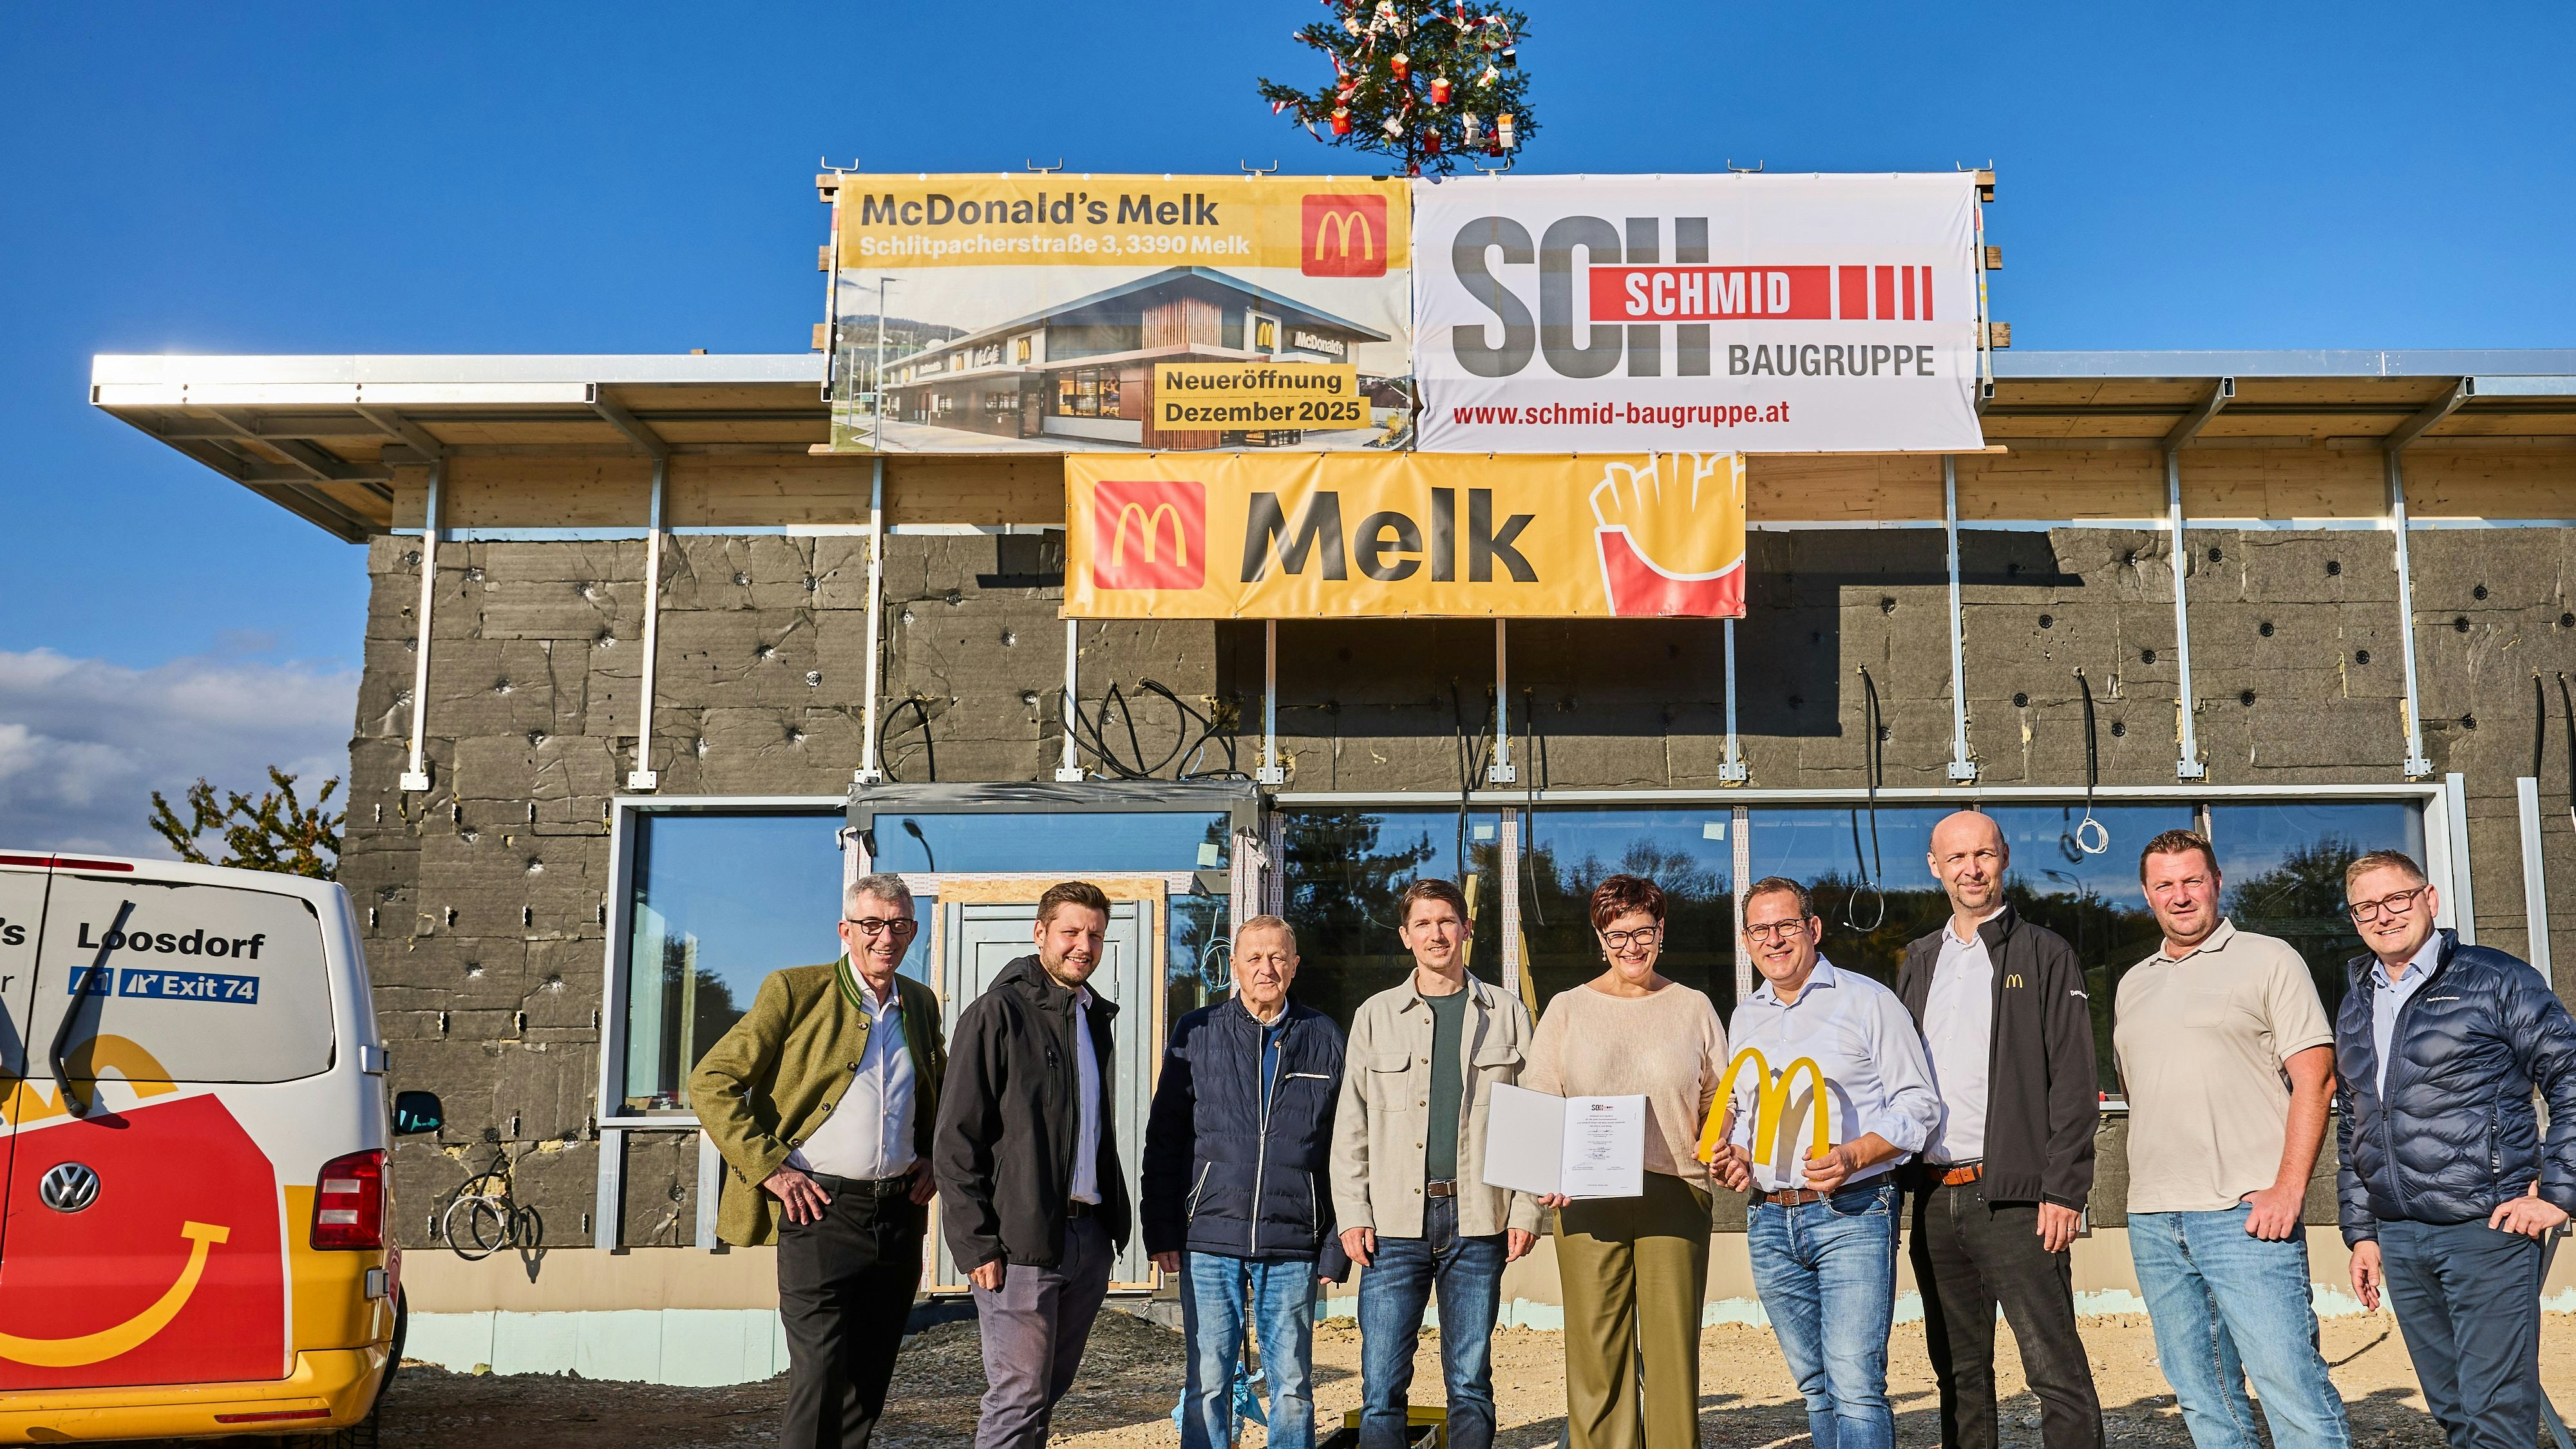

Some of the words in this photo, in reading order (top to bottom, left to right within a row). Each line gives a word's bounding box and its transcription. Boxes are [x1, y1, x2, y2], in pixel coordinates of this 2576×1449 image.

[861, 192, 1108, 226] McDonald’s
[1117, 193, 1220, 225] Melk
[860, 234, 1098, 260] Schlitpacherstraße
[1102, 236, 1122, 256] 3,
[1126, 235, 1186, 254] 3390
[1190, 234, 1251, 255] Melk
[1625, 271, 1791, 316] SCHMID
[1728, 343, 1935, 377] BAUGRUPPE
[1166, 369, 1342, 394] Neueröffnung
[1166, 402, 1294, 422] Dezember
[1299, 401, 1361, 421] 2025
[1453, 401, 1790, 428] www.schmid-baugruppe.at
[1240, 487, 1539, 583] Melk
[77, 922, 266, 960] Loosdorf
[162, 976, 218, 998] Exit
[223, 980, 254, 999] 74
